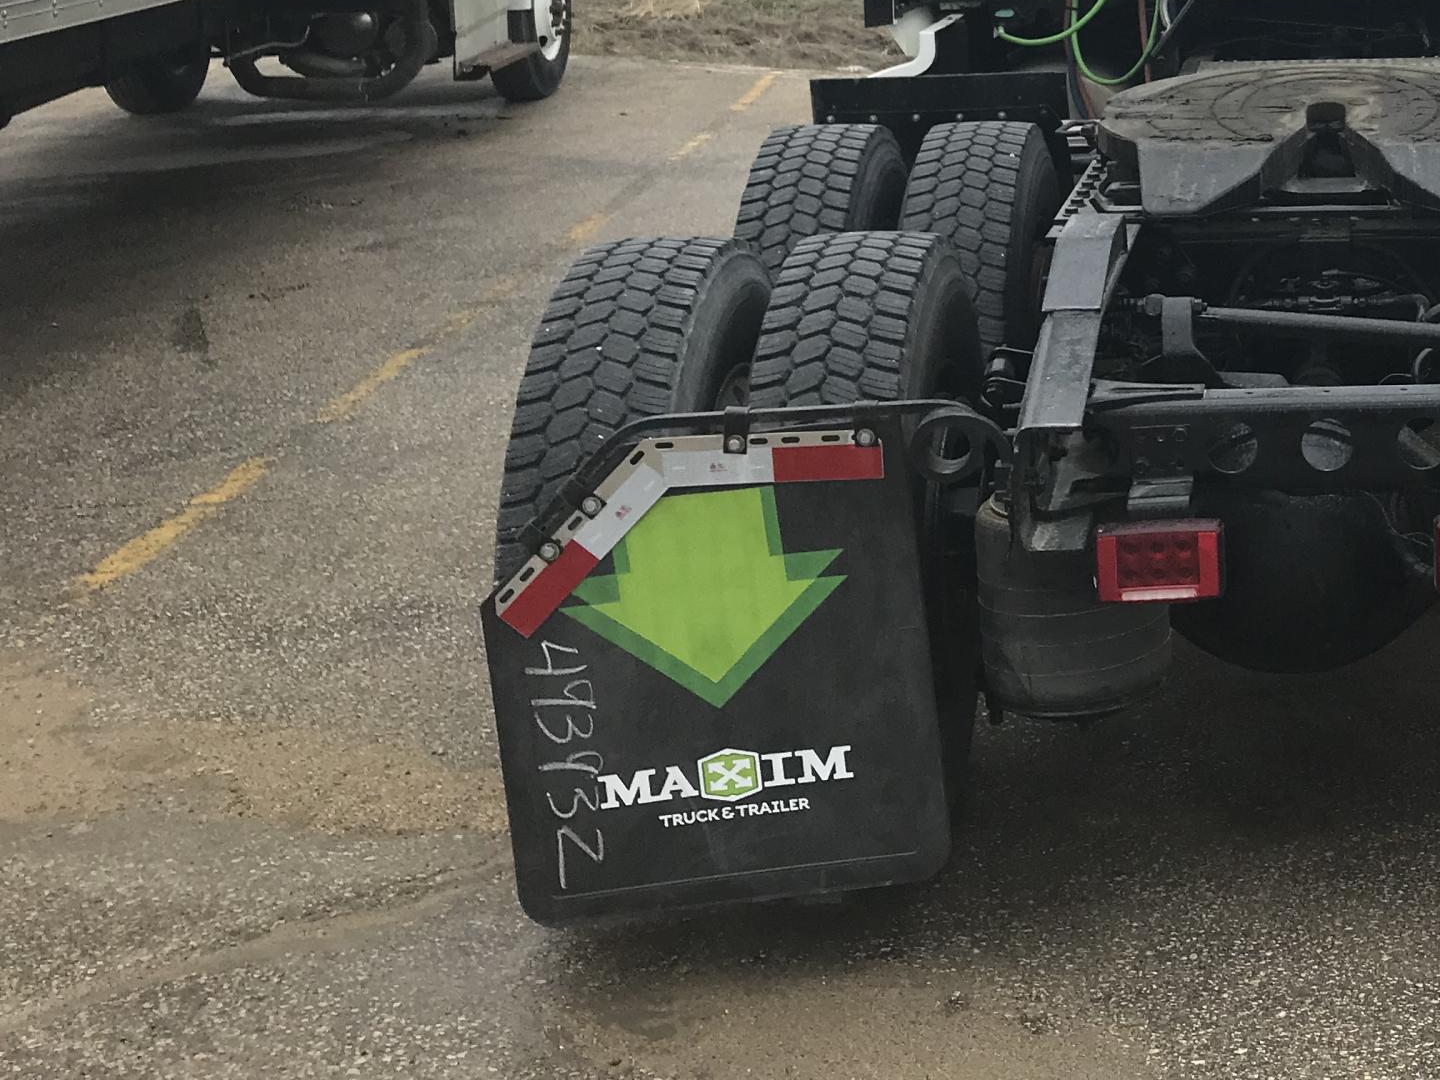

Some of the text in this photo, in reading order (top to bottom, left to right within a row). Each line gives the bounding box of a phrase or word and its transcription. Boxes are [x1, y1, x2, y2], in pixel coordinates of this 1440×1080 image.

[598, 745, 855, 810] MAXIM
[659, 808, 720, 828] TRUCK
[735, 797, 811, 819] TRAILER
